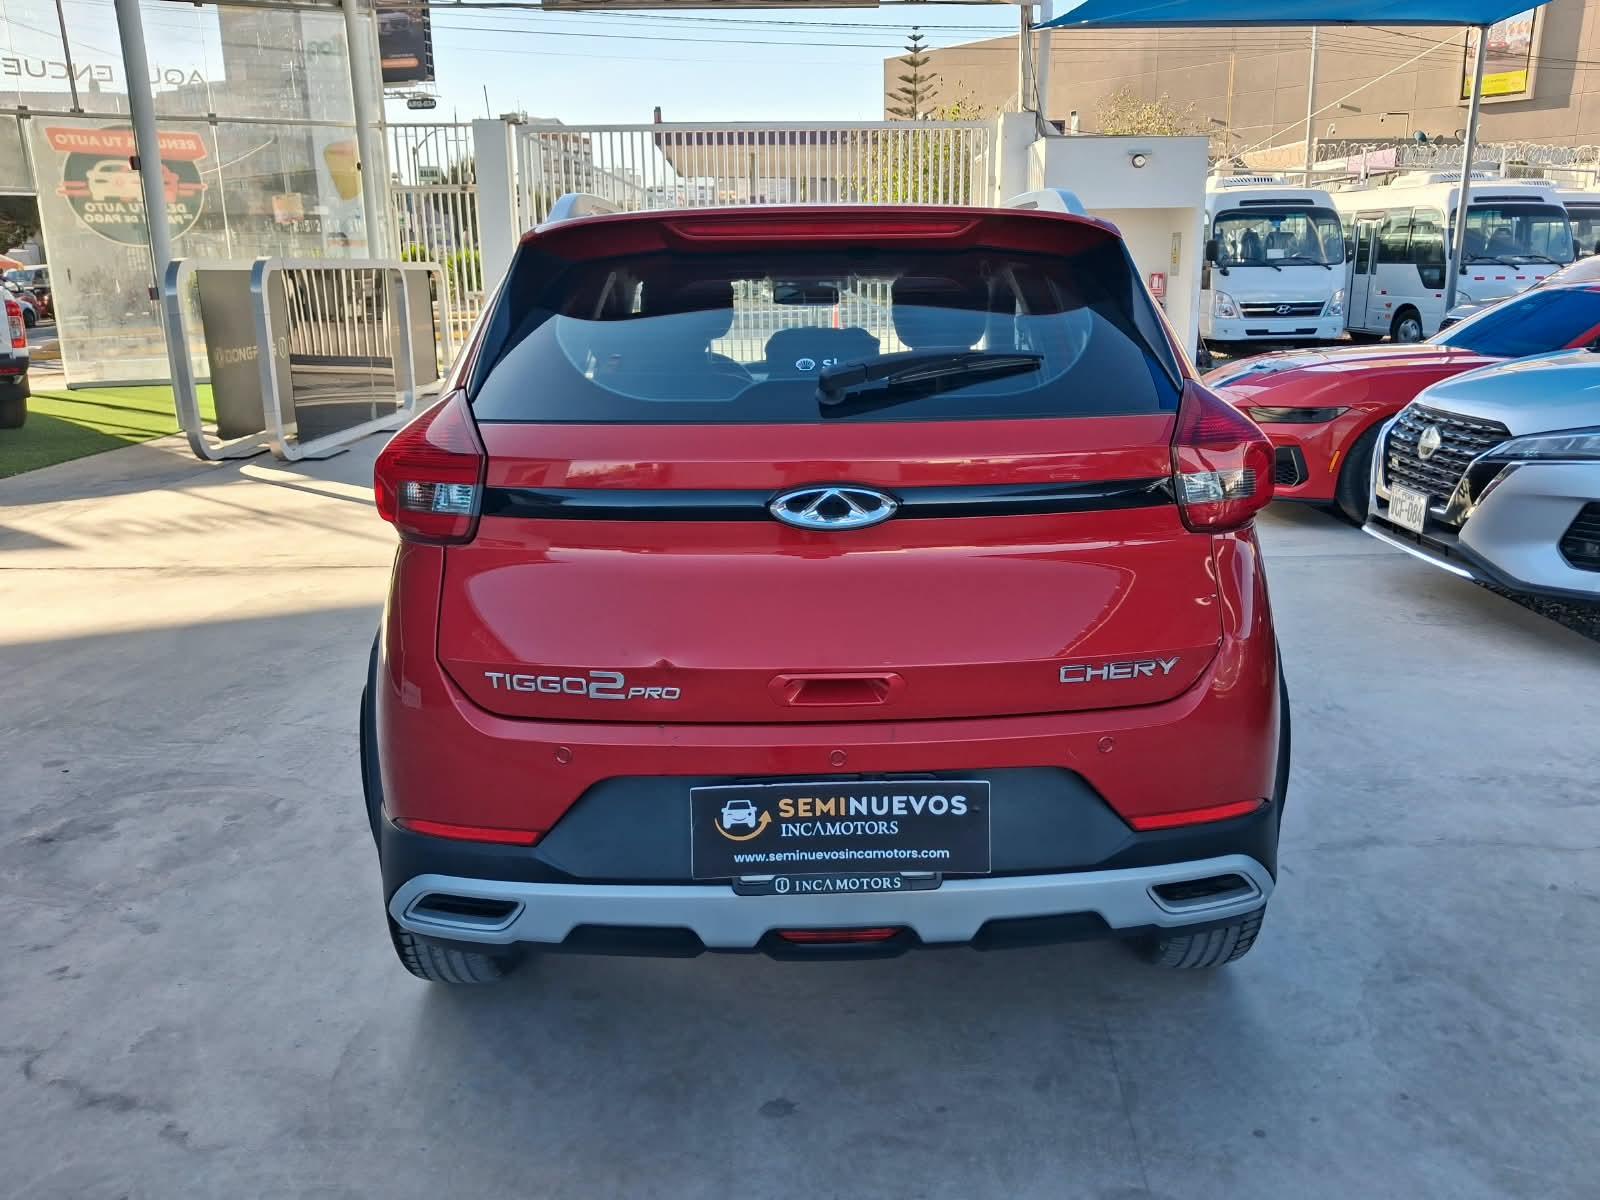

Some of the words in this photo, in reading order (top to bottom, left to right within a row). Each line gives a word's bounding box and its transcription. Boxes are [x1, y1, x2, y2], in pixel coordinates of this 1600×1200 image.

[1060, 656, 1180, 683] CHERY
[778, 795, 968, 818] SEMINUEVOS
[780, 820, 899, 837] INCAMOTORS
[733, 848, 950, 863] www.seminuevosincamotors.com
